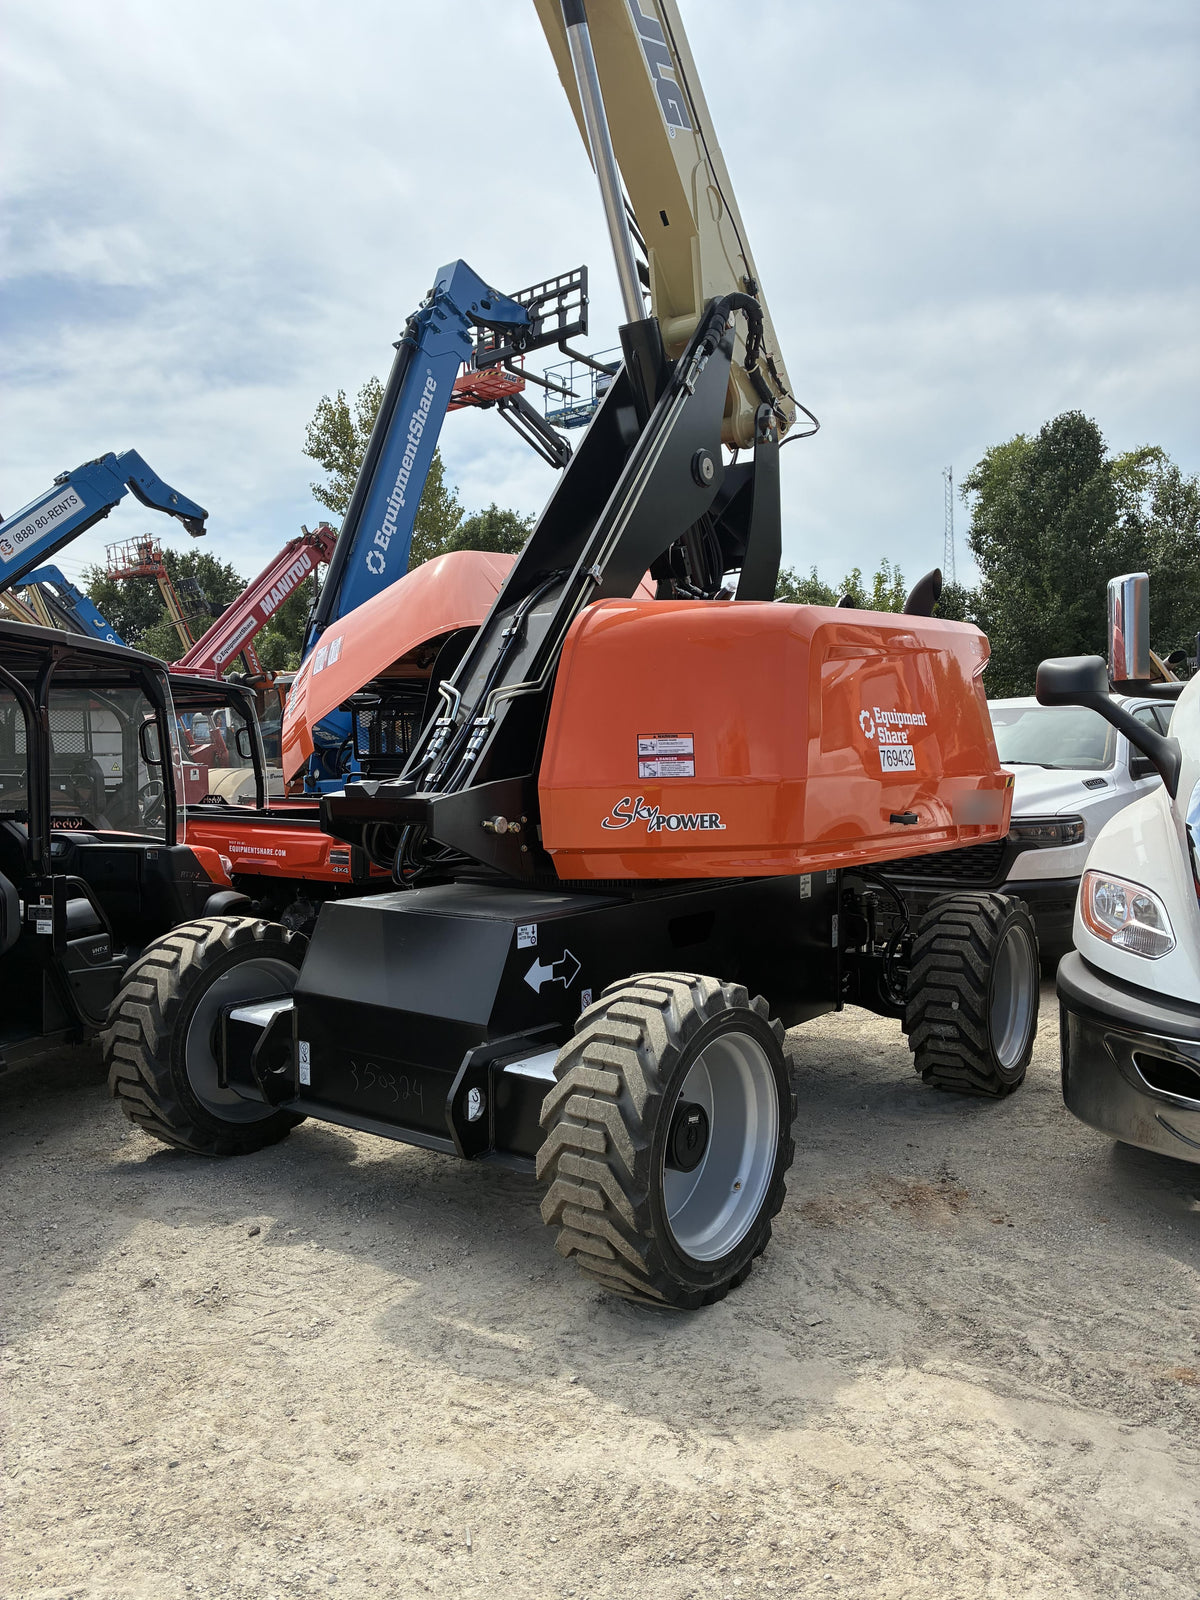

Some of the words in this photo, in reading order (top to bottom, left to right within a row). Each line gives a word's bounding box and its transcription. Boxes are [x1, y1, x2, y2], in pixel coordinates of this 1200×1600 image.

[503, 373, 517, 383] JLG
[374, 380, 438, 552] EquipmentShare
[13, 523, 37, 545] (888)
[34, 494, 78, 529] 80-RENTS
[259, 552, 312, 617] MANITOU
[220, 620, 254, 657] EquipmentShare
[872, 706, 928, 728] Equipment
[877, 726, 908, 744] Share
[880, 749, 915, 767] 769432
[228, 844, 287, 857] EQUIPMENTSHARE.COM
